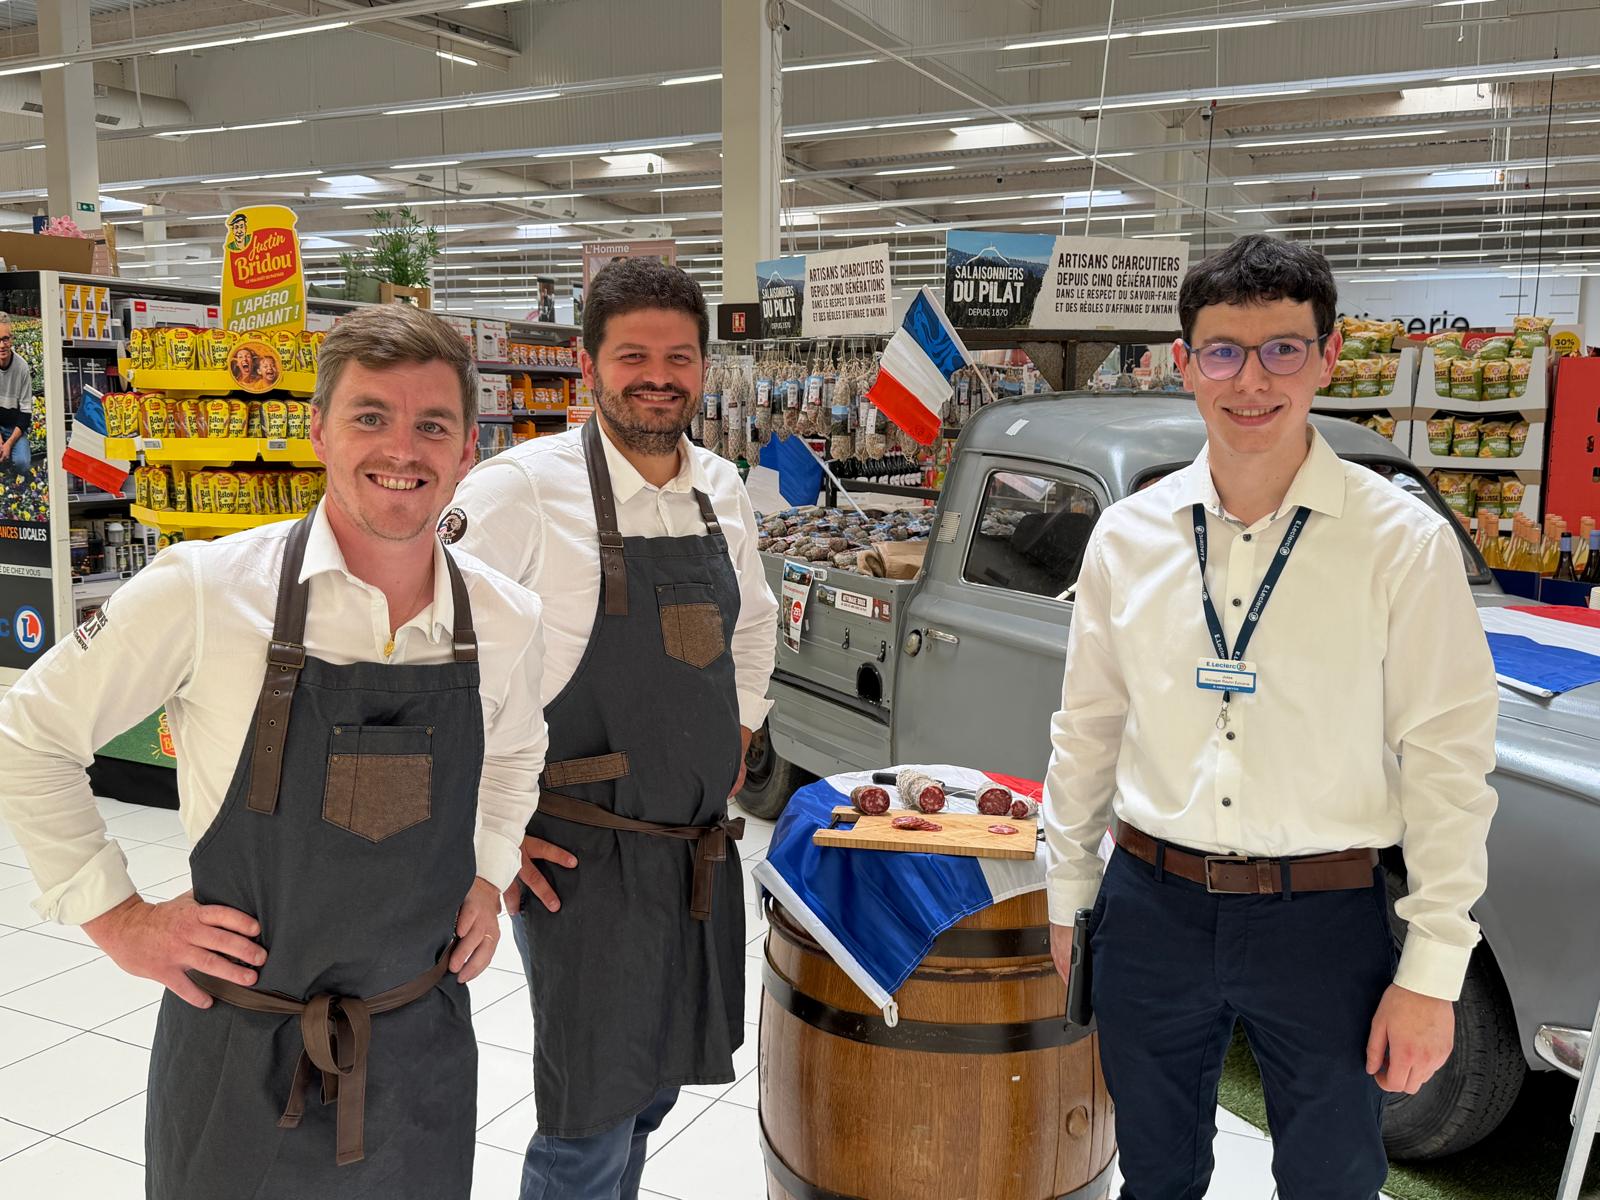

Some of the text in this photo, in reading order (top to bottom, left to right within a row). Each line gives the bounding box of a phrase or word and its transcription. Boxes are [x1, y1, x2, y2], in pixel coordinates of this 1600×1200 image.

[249, 231, 286, 261] Justin
[585, 244, 630, 254] L'Homme
[234, 252, 292, 281] Bridou
[1058, 252, 1180, 271] ARTISANS CHARCUTIERS
[810, 259, 884, 282] ARTISANS CHARCUTIERS
[955, 266, 1024, 280] SALAISONNIERS
[1057, 271, 1178, 288] DEPUIS CINQ GÉNÉRATIONS
[762, 286, 794, 299] SALAISONNIERS
[810, 278, 884, 298] DEPUIS CINQ GÉNÉRATIONS
[953, 280, 1024, 303] DU PILAT
[1056, 288, 1177, 301] DANS LE RESPECT DU SAVOIR-FAIRE
[236, 290, 289, 316] L'APÉRO
[763, 298, 796, 318] DU PILAT
[812, 299, 822, 309] DANS
[824, 299, 828, 308] LE
[829, 297, 847, 308] RESPECT
[855, 294, 886, 305] SAVOIR-FAIRE
[1055, 302, 1064, 312] ET
[1065, 303, 1078, 313] DES
[1080, 300, 1104, 313] RÈGLES
[1106, 303, 1142, 314] D'AFFINAGE
[1146, 304, 1173, 314] D'ANTAN
[229, 304, 300, 332] GAGNANT !
[968, 308, 1008, 317] DEPUIS 1870
[1554, 338, 1574, 346] 30%
[19, 527, 47, 541] LOCALES
[11, 567, 24, 575] CHEZ
[26, 569, 40, 577] VOUS
